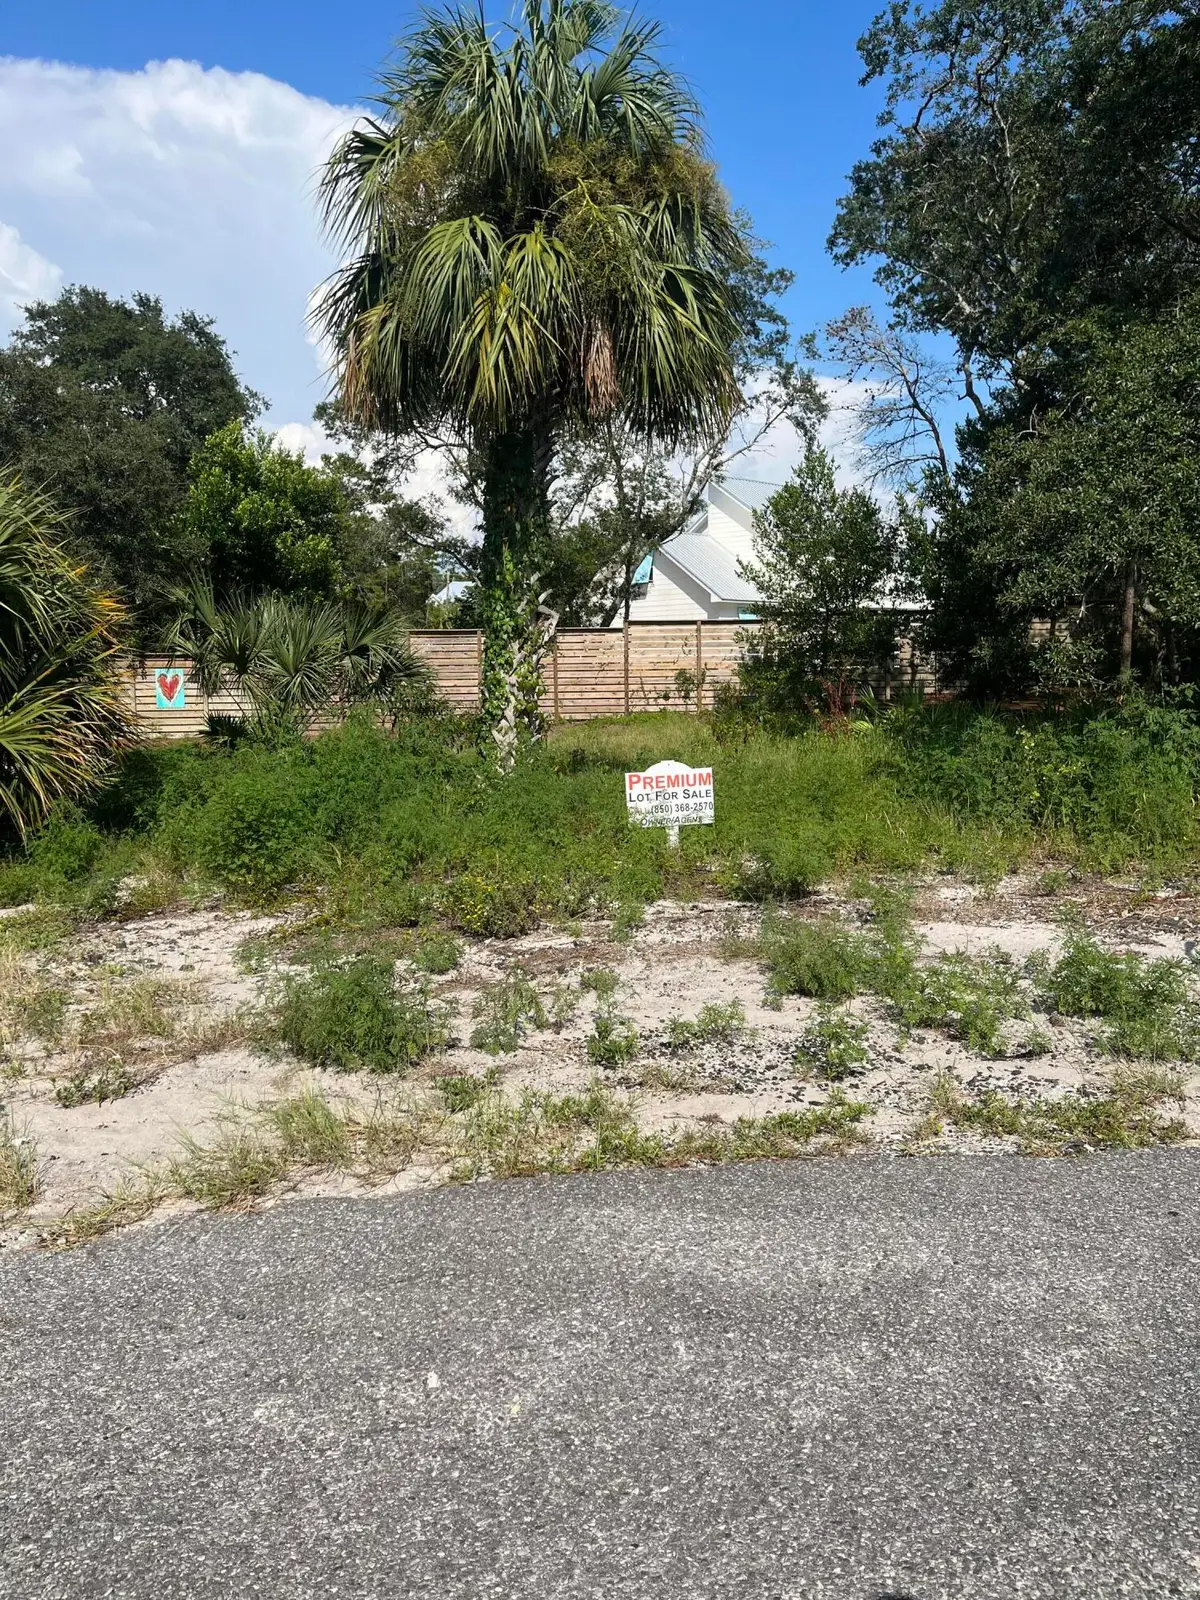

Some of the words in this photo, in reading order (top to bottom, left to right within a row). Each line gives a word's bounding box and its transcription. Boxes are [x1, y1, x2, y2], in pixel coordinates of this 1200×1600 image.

[628, 772, 711, 790] PREMIUM
[629, 792, 651, 803] LOT
[655, 790, 678, 801] FOR
[683, 789, 711, 799] SALE
[651, 804, 673, 815] (850)
[675, 801, 713, 813] 368-2570
